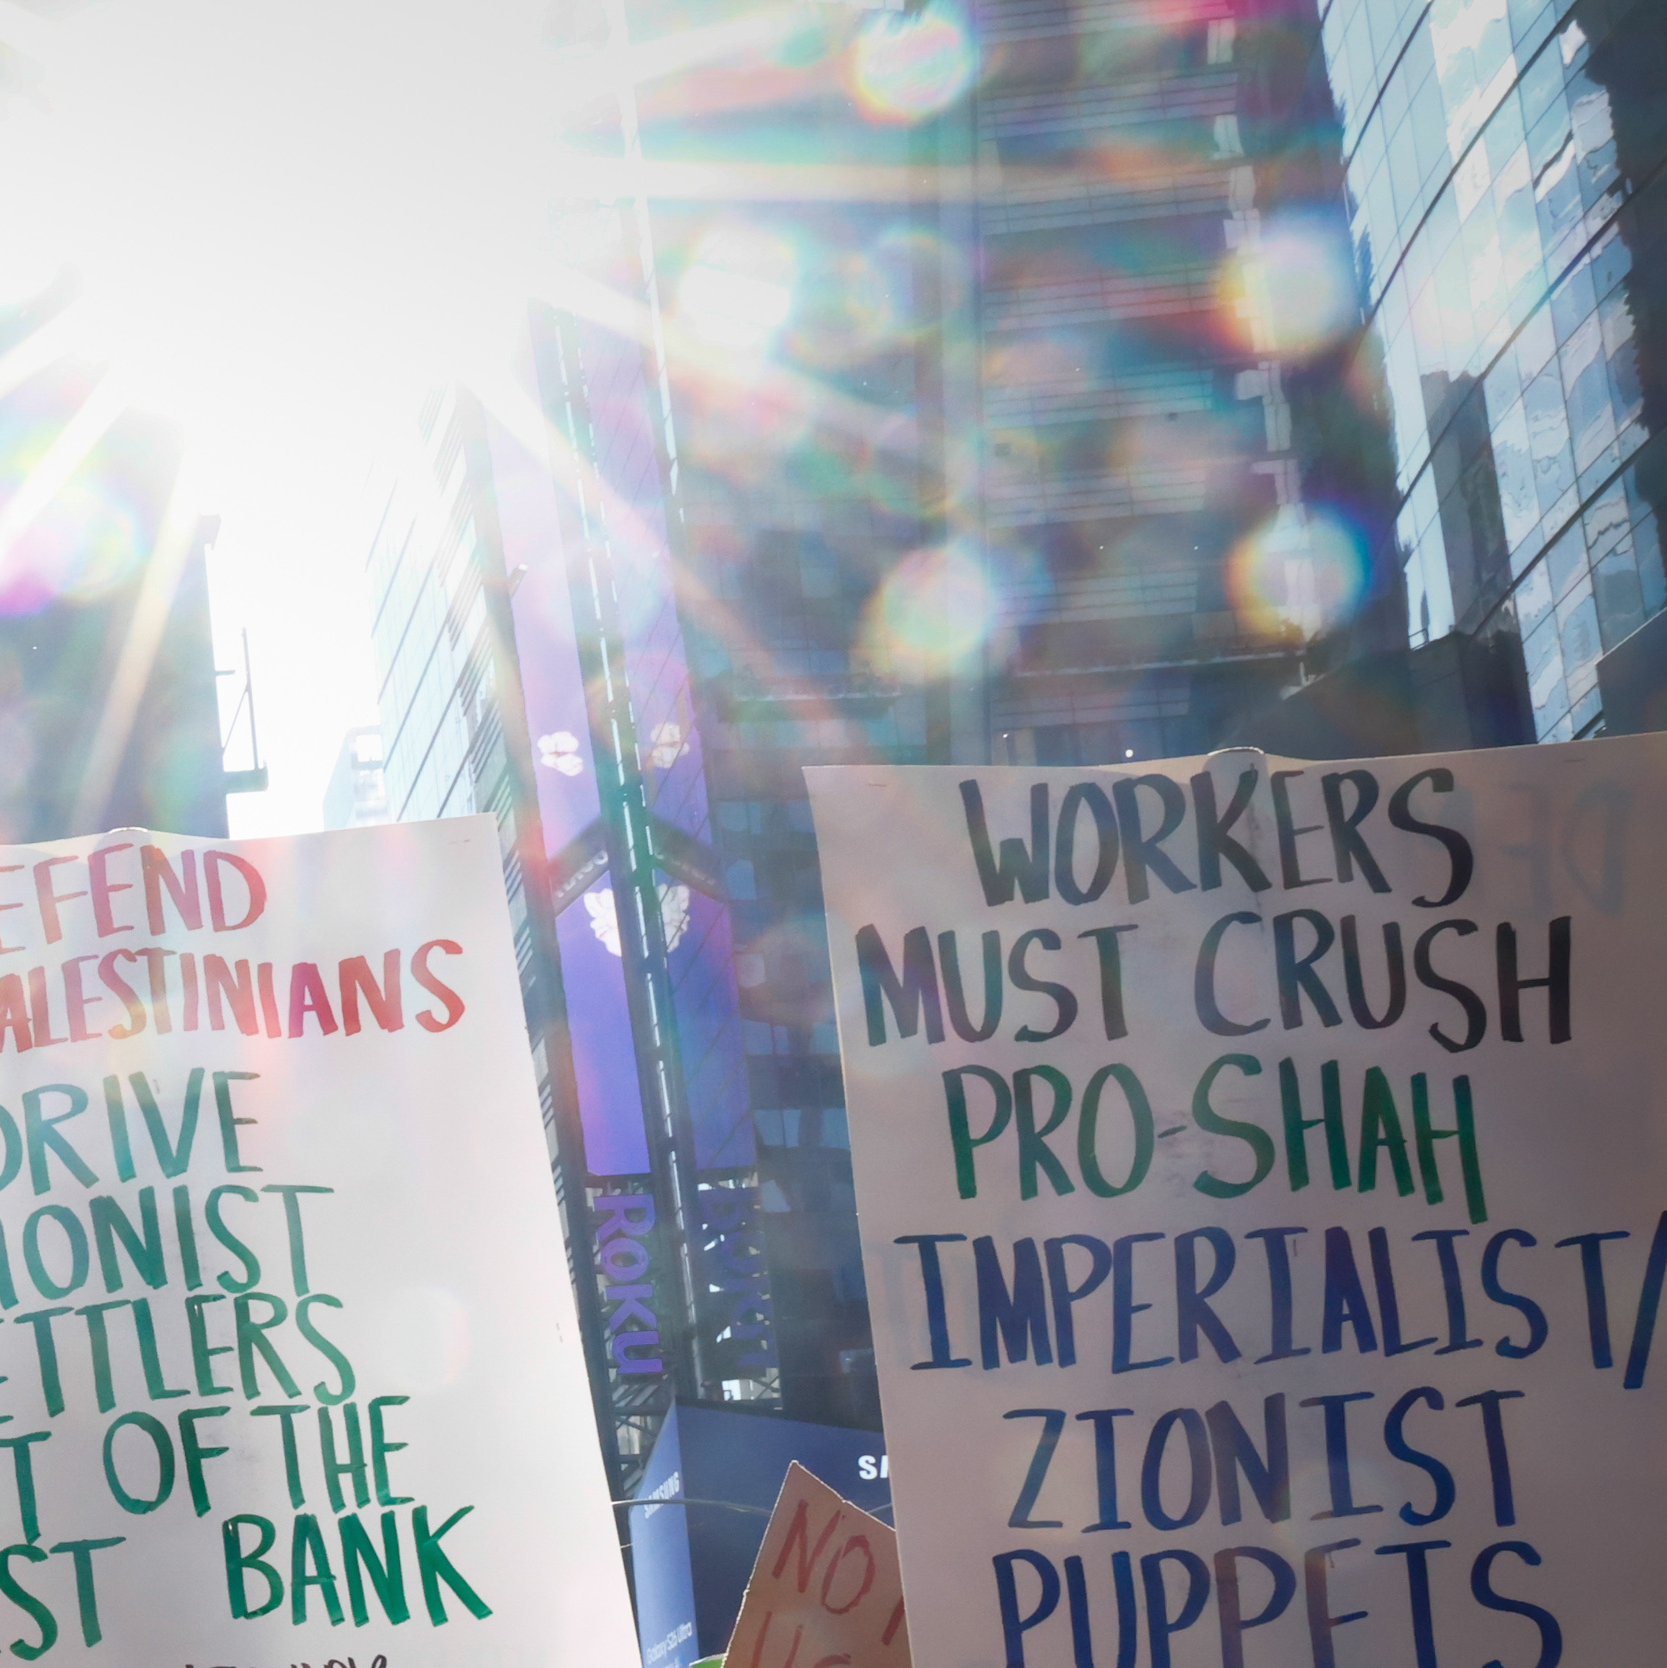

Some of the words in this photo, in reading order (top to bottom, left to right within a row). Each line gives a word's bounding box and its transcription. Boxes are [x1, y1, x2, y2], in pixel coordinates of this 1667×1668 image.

[959, 767, 1474, 909] WORKERS
[855, 922, 1139, 1048] MUST
[1194, 908, 1571, 1054] CRUSH
[942, 1052, 1490, 1225] PRO-SHAH
[893, 1208, 1667, 1390] IMPERIALIST/
[101, 1404, 231, 1517] OF
[249, 1394, 415, 1515] THE
[644, 1471, 680, 1520] SAMSUNG
[1002, 1385, 1527, 1534] ZIONIST
[222, 1504, 494, 1629] BANK
[772, 1500, 876, 1615] NO
